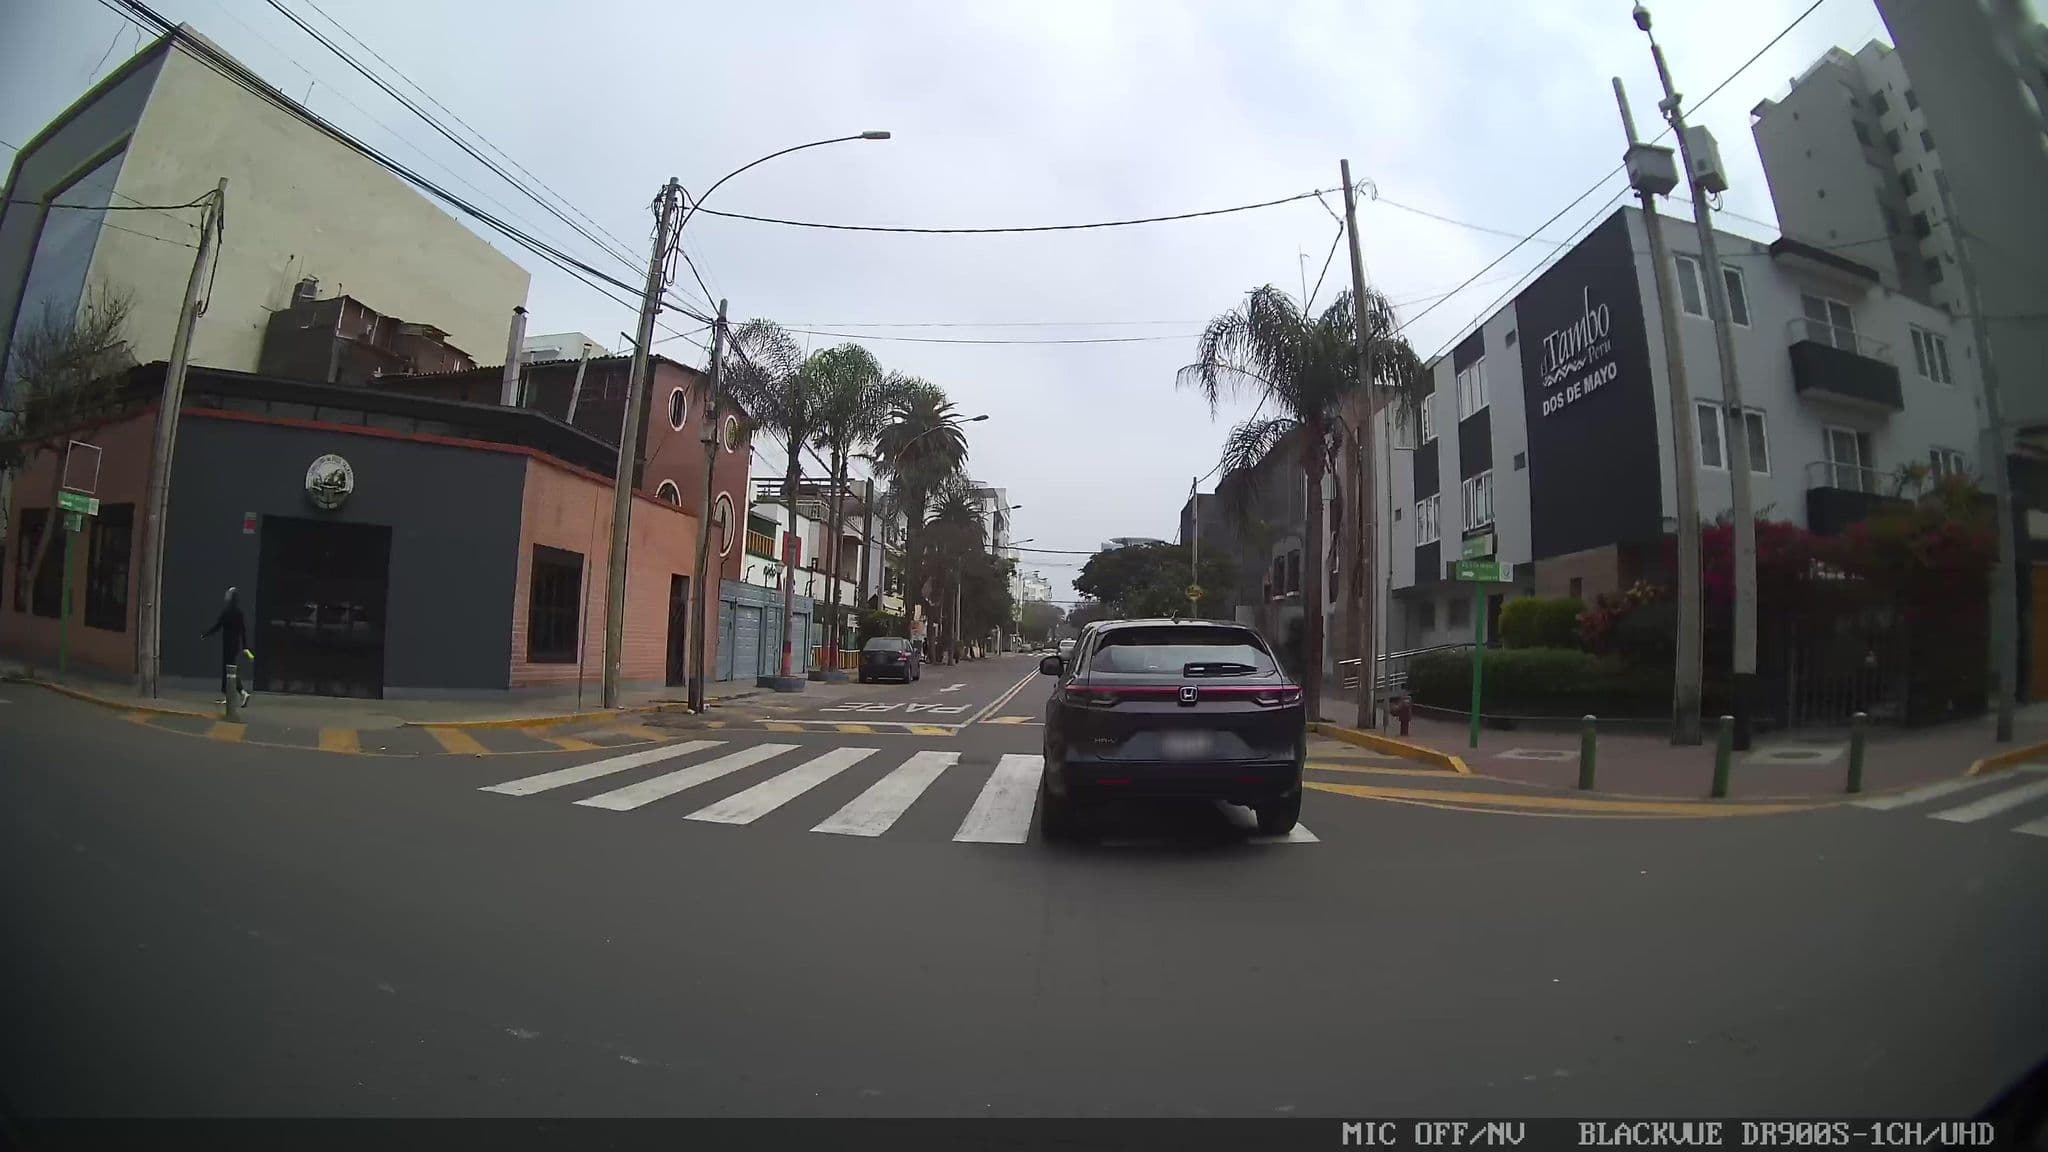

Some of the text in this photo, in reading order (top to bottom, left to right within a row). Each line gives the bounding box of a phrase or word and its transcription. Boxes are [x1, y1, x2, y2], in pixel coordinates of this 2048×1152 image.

[1543, 285, 1609, 372] Tambo
[1543, 361, 1617, 416] DOS DE MAYO
